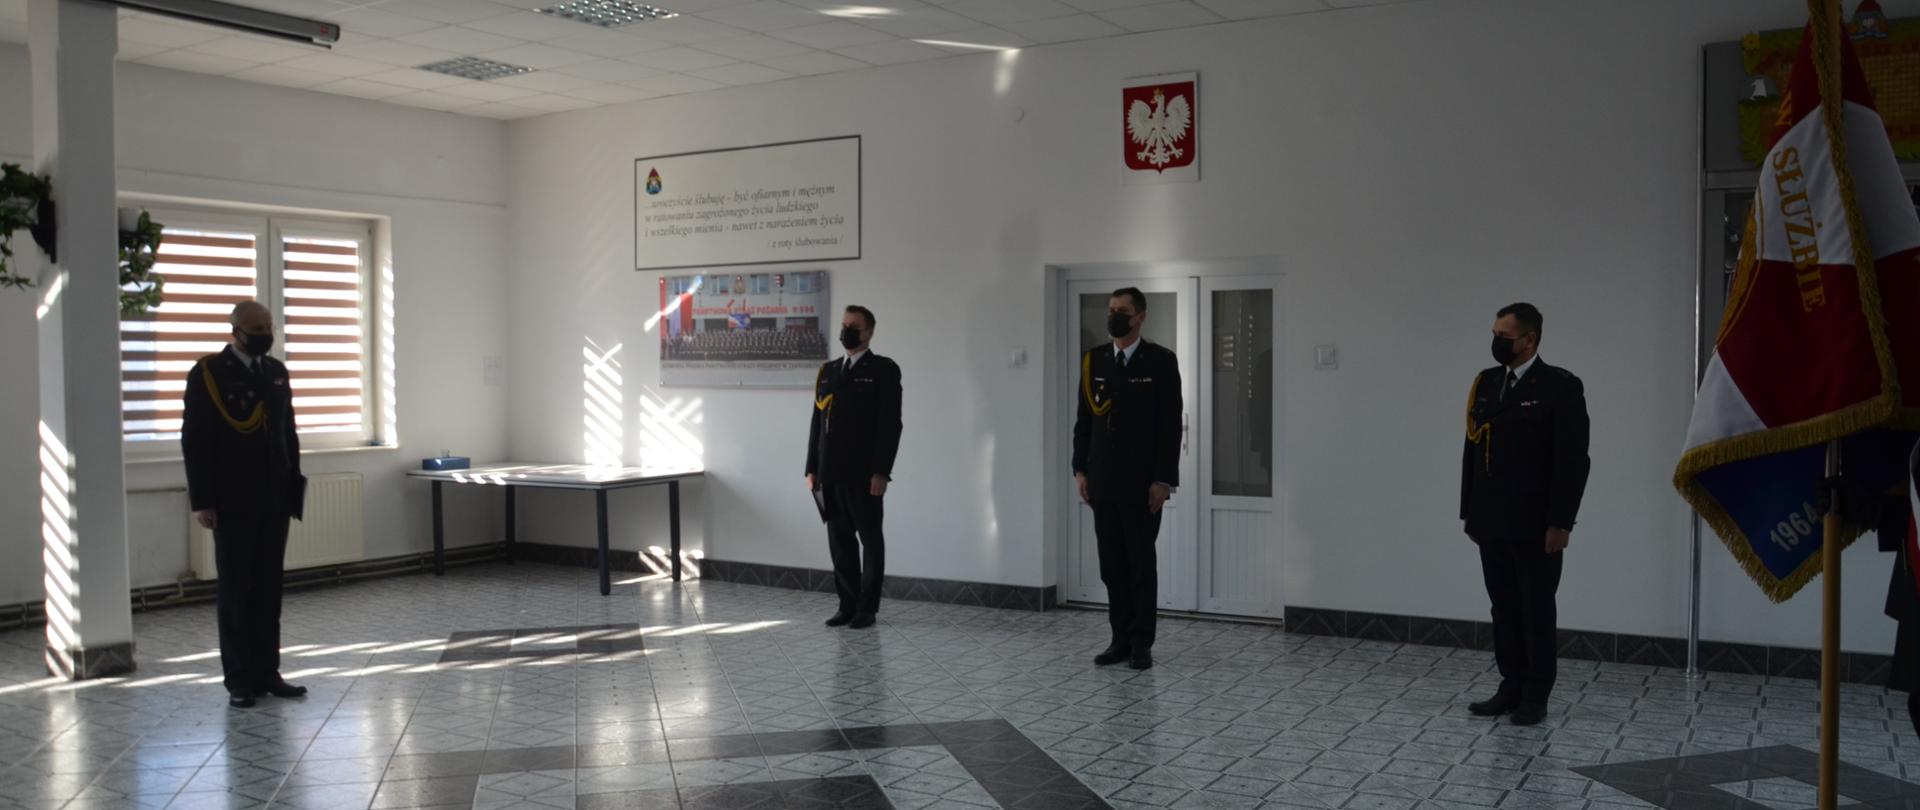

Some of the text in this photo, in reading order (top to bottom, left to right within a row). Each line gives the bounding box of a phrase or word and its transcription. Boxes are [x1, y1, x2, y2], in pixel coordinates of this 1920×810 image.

[695, 193, 725, 206] ślubuję
[734, 190, 749, 204] być
[751, 188, 790, 203] ofiarnym
[798, 185, 835, 199] mężnym
[695, 206, 750, 222] zagrożonego
[751, 204, 774, 216] życia
[776, 199, 819, 214] ludzkiego
[651, 224, 693, 240] wszelkiego
[694, 222, 724, 234] mienia
[731, 220, 758, 233] nawet
[766, 216, 818, 230] narażeniem
[819, 214, 844, 228] życia
[1773, 146, 1827, 313] SŁUŻBIE
[1770, 500, 1824, 551] 1964
